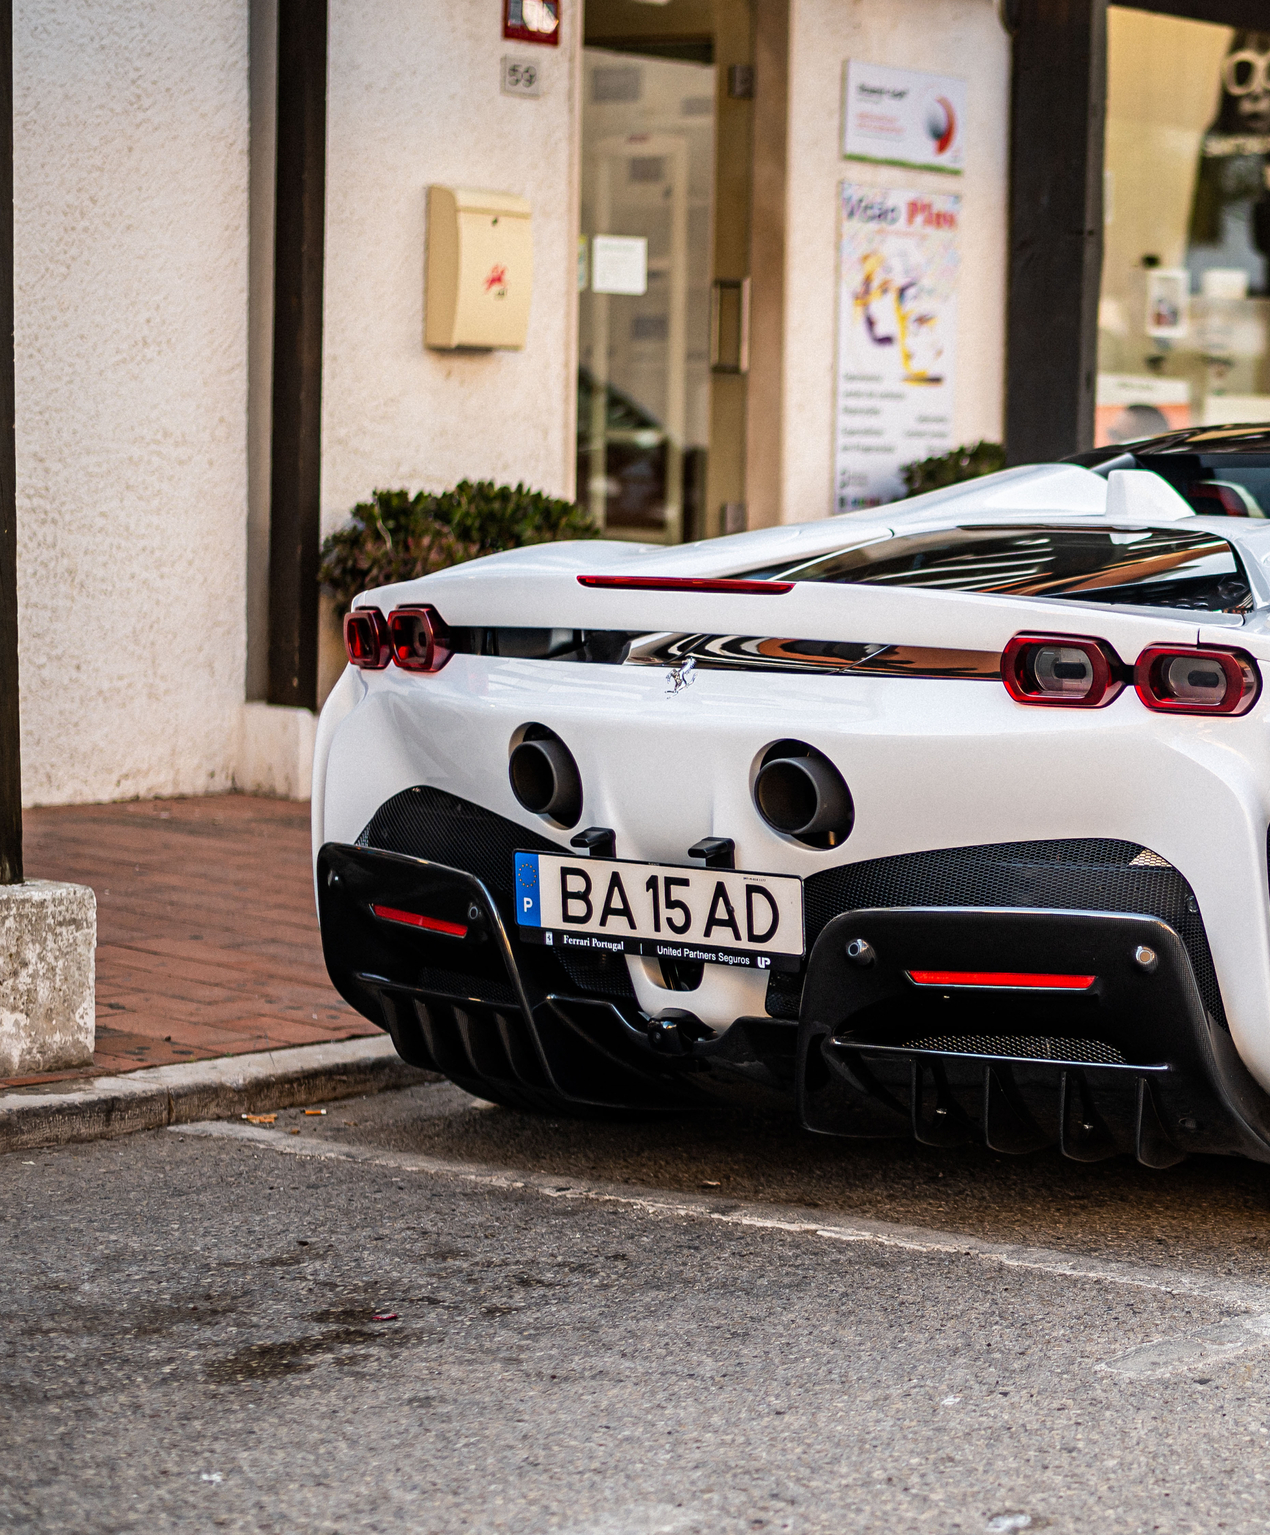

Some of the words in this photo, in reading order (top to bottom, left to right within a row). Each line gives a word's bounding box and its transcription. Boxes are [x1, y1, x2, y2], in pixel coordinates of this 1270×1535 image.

[508, 63, 537, 88] 59
[523, 898, 533, 912] P
[559, 866, 638, 930] BA
[645, 875, 692, 935] 15
[703, 881, 780, 943] AD
[563, 934, 590, 945] Ferrari
[591, 937, 624, 951] Portugal
[657, 945, 682, 957] United
[683, 948, 717, 962] Partners
[718, 952, 750, 965] Seguros
